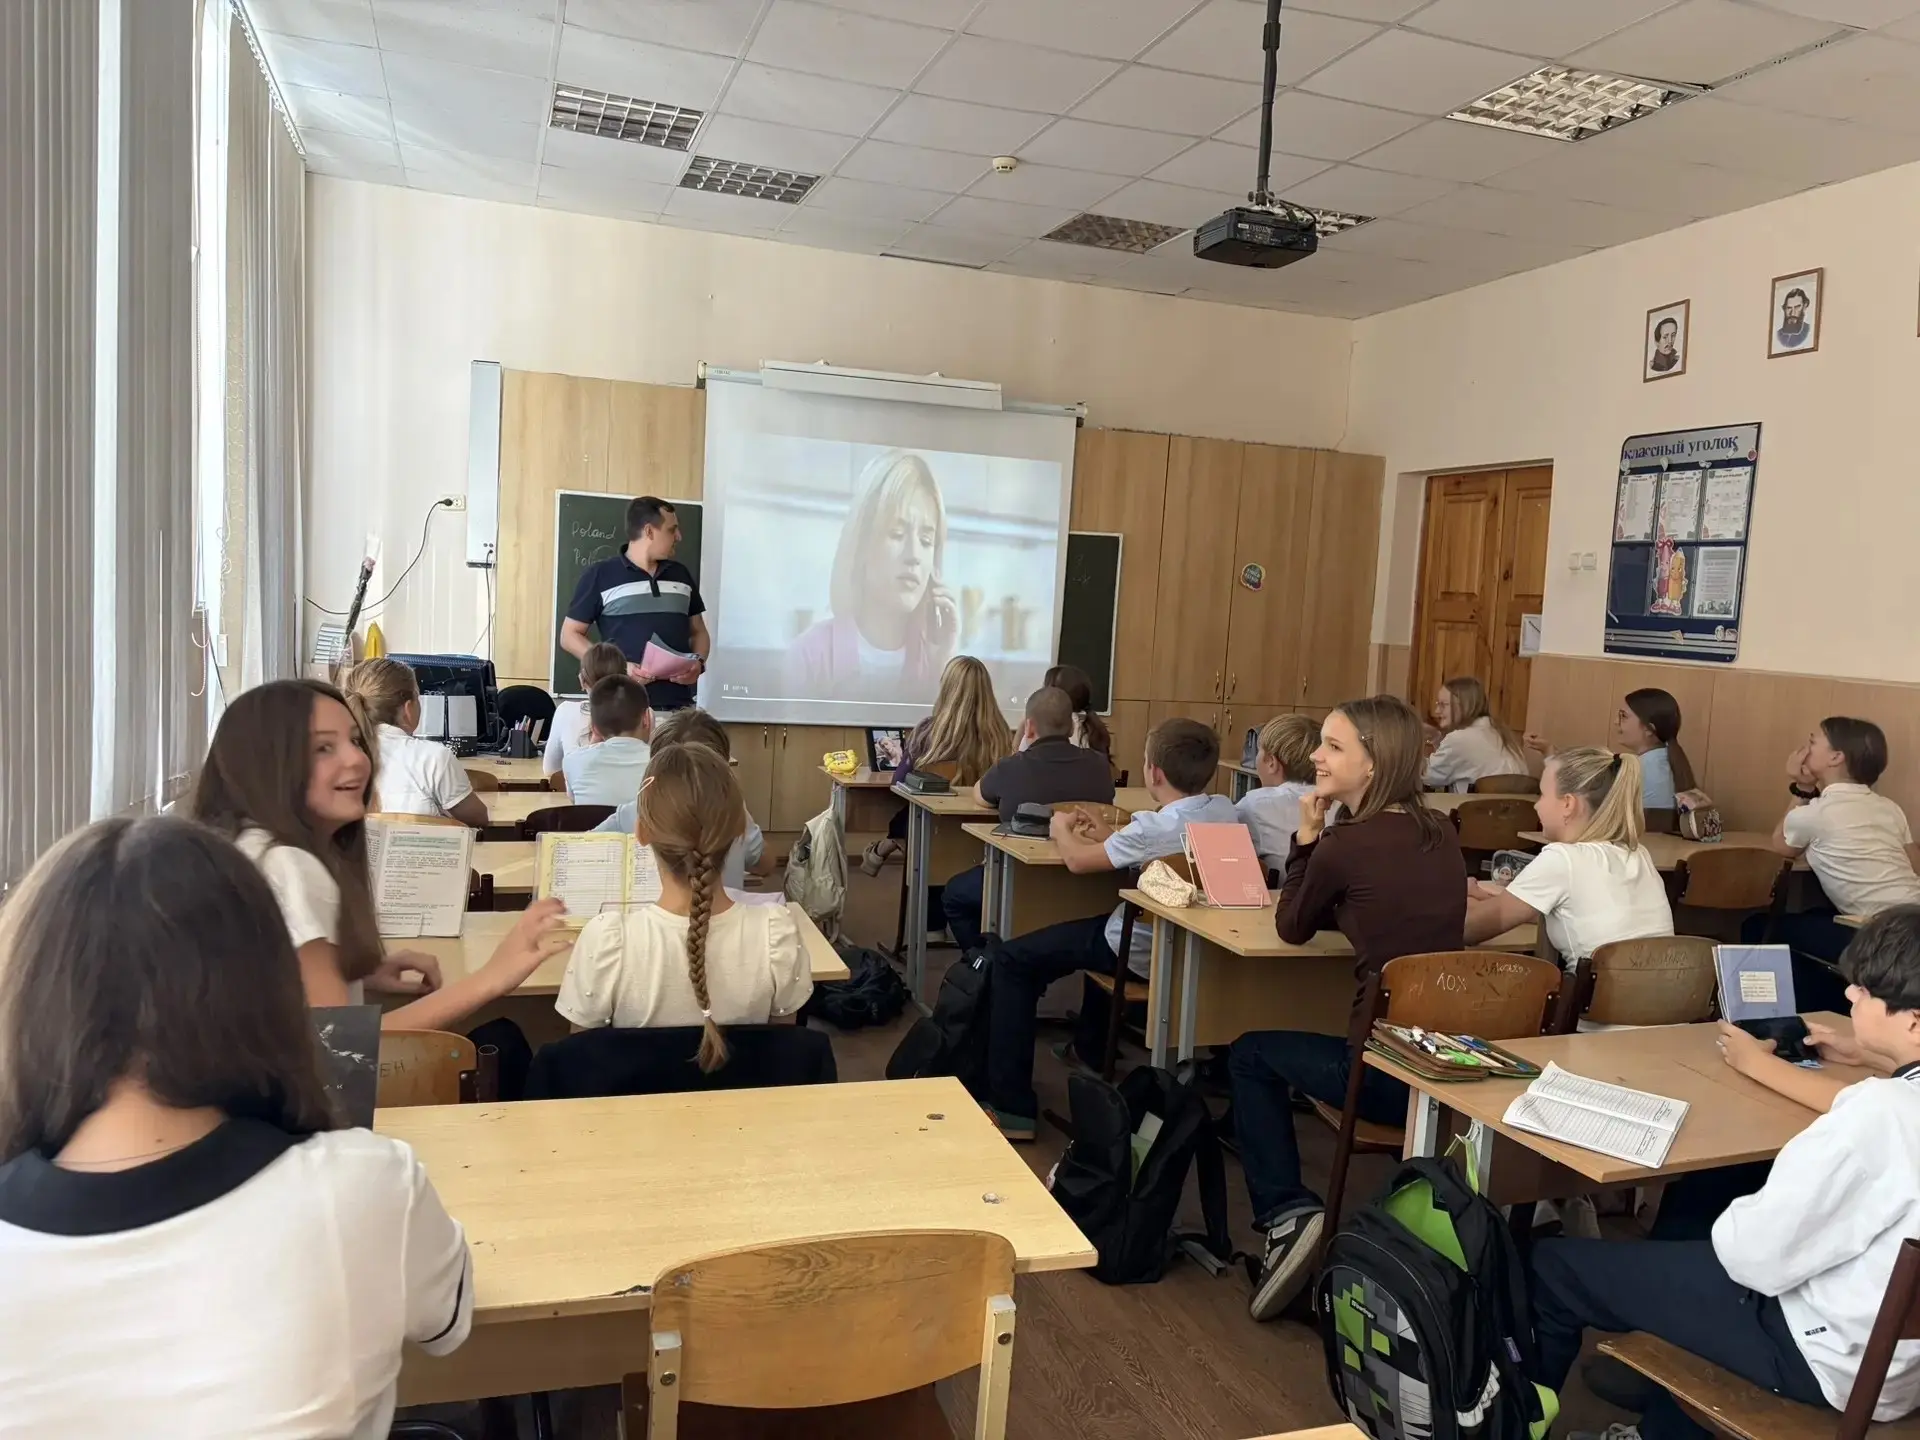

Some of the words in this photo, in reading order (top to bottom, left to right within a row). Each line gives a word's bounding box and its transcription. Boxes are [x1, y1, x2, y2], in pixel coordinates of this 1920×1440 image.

[1624, 439, 1685, 460] классный
[1687, 435, 1739, 457] уголок
[571, 520, 617, 540] Poland
